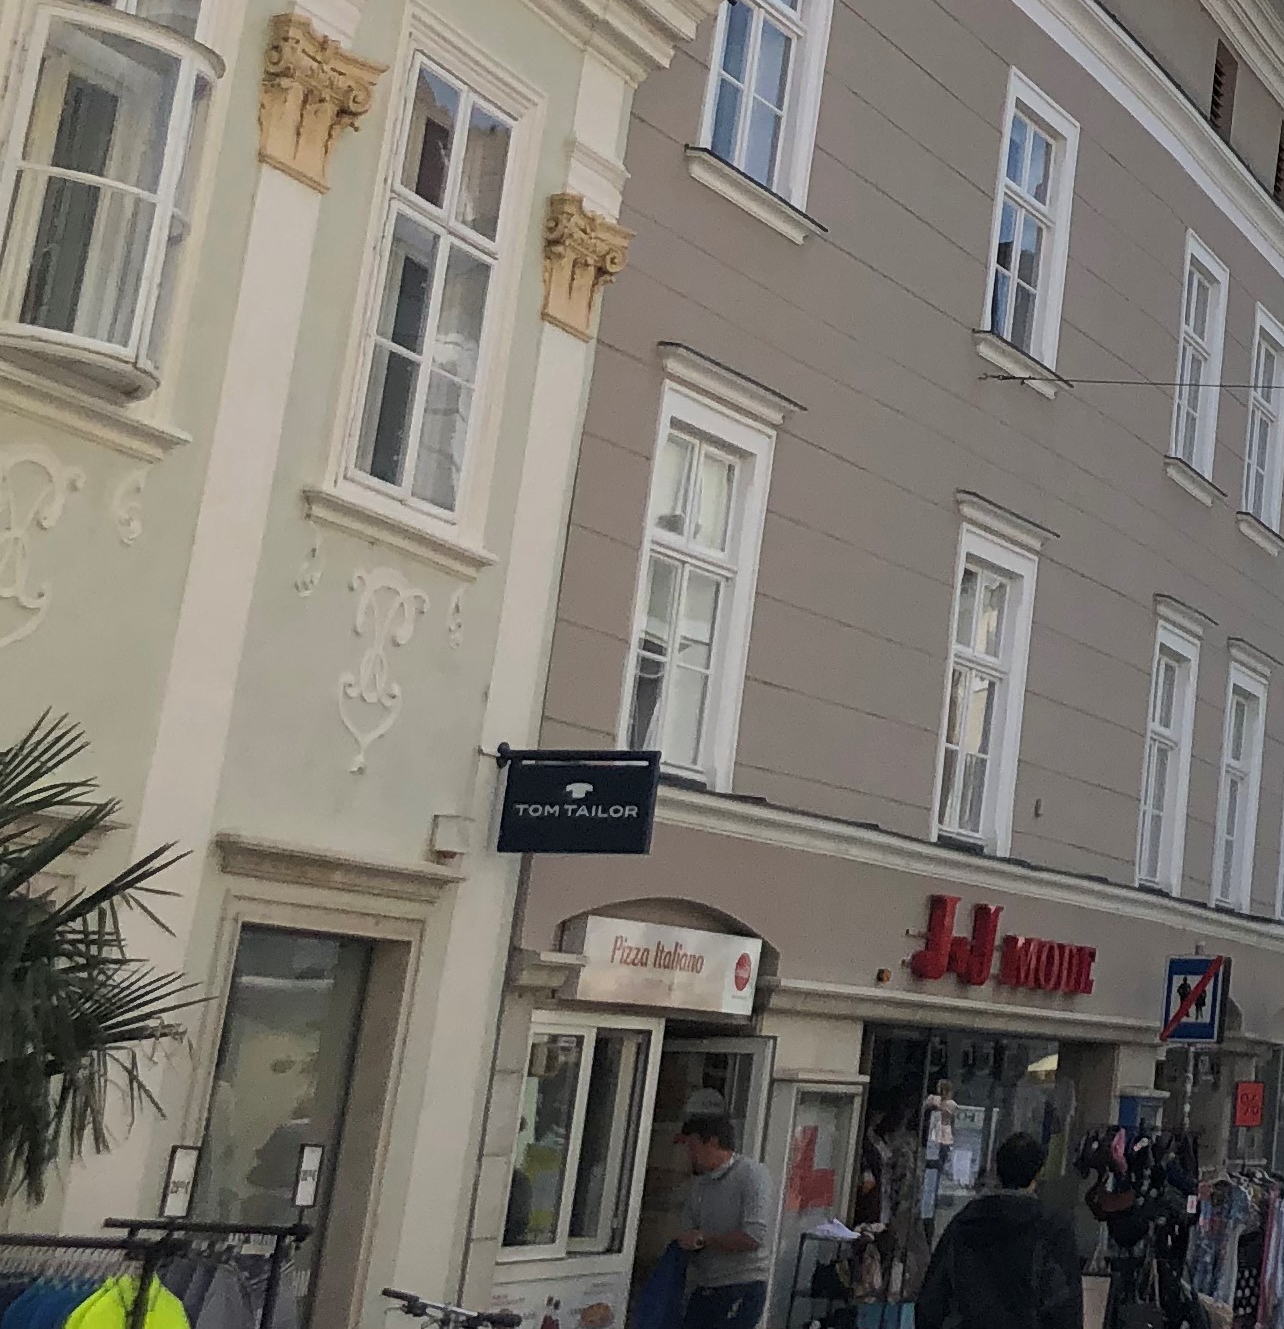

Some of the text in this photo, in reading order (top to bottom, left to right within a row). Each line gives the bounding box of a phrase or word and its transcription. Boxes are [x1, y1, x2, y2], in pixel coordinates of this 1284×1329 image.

[515, 804, 638, 818] TOM TAILOR
[611, 934, 705, 973] Pizza Italiano
